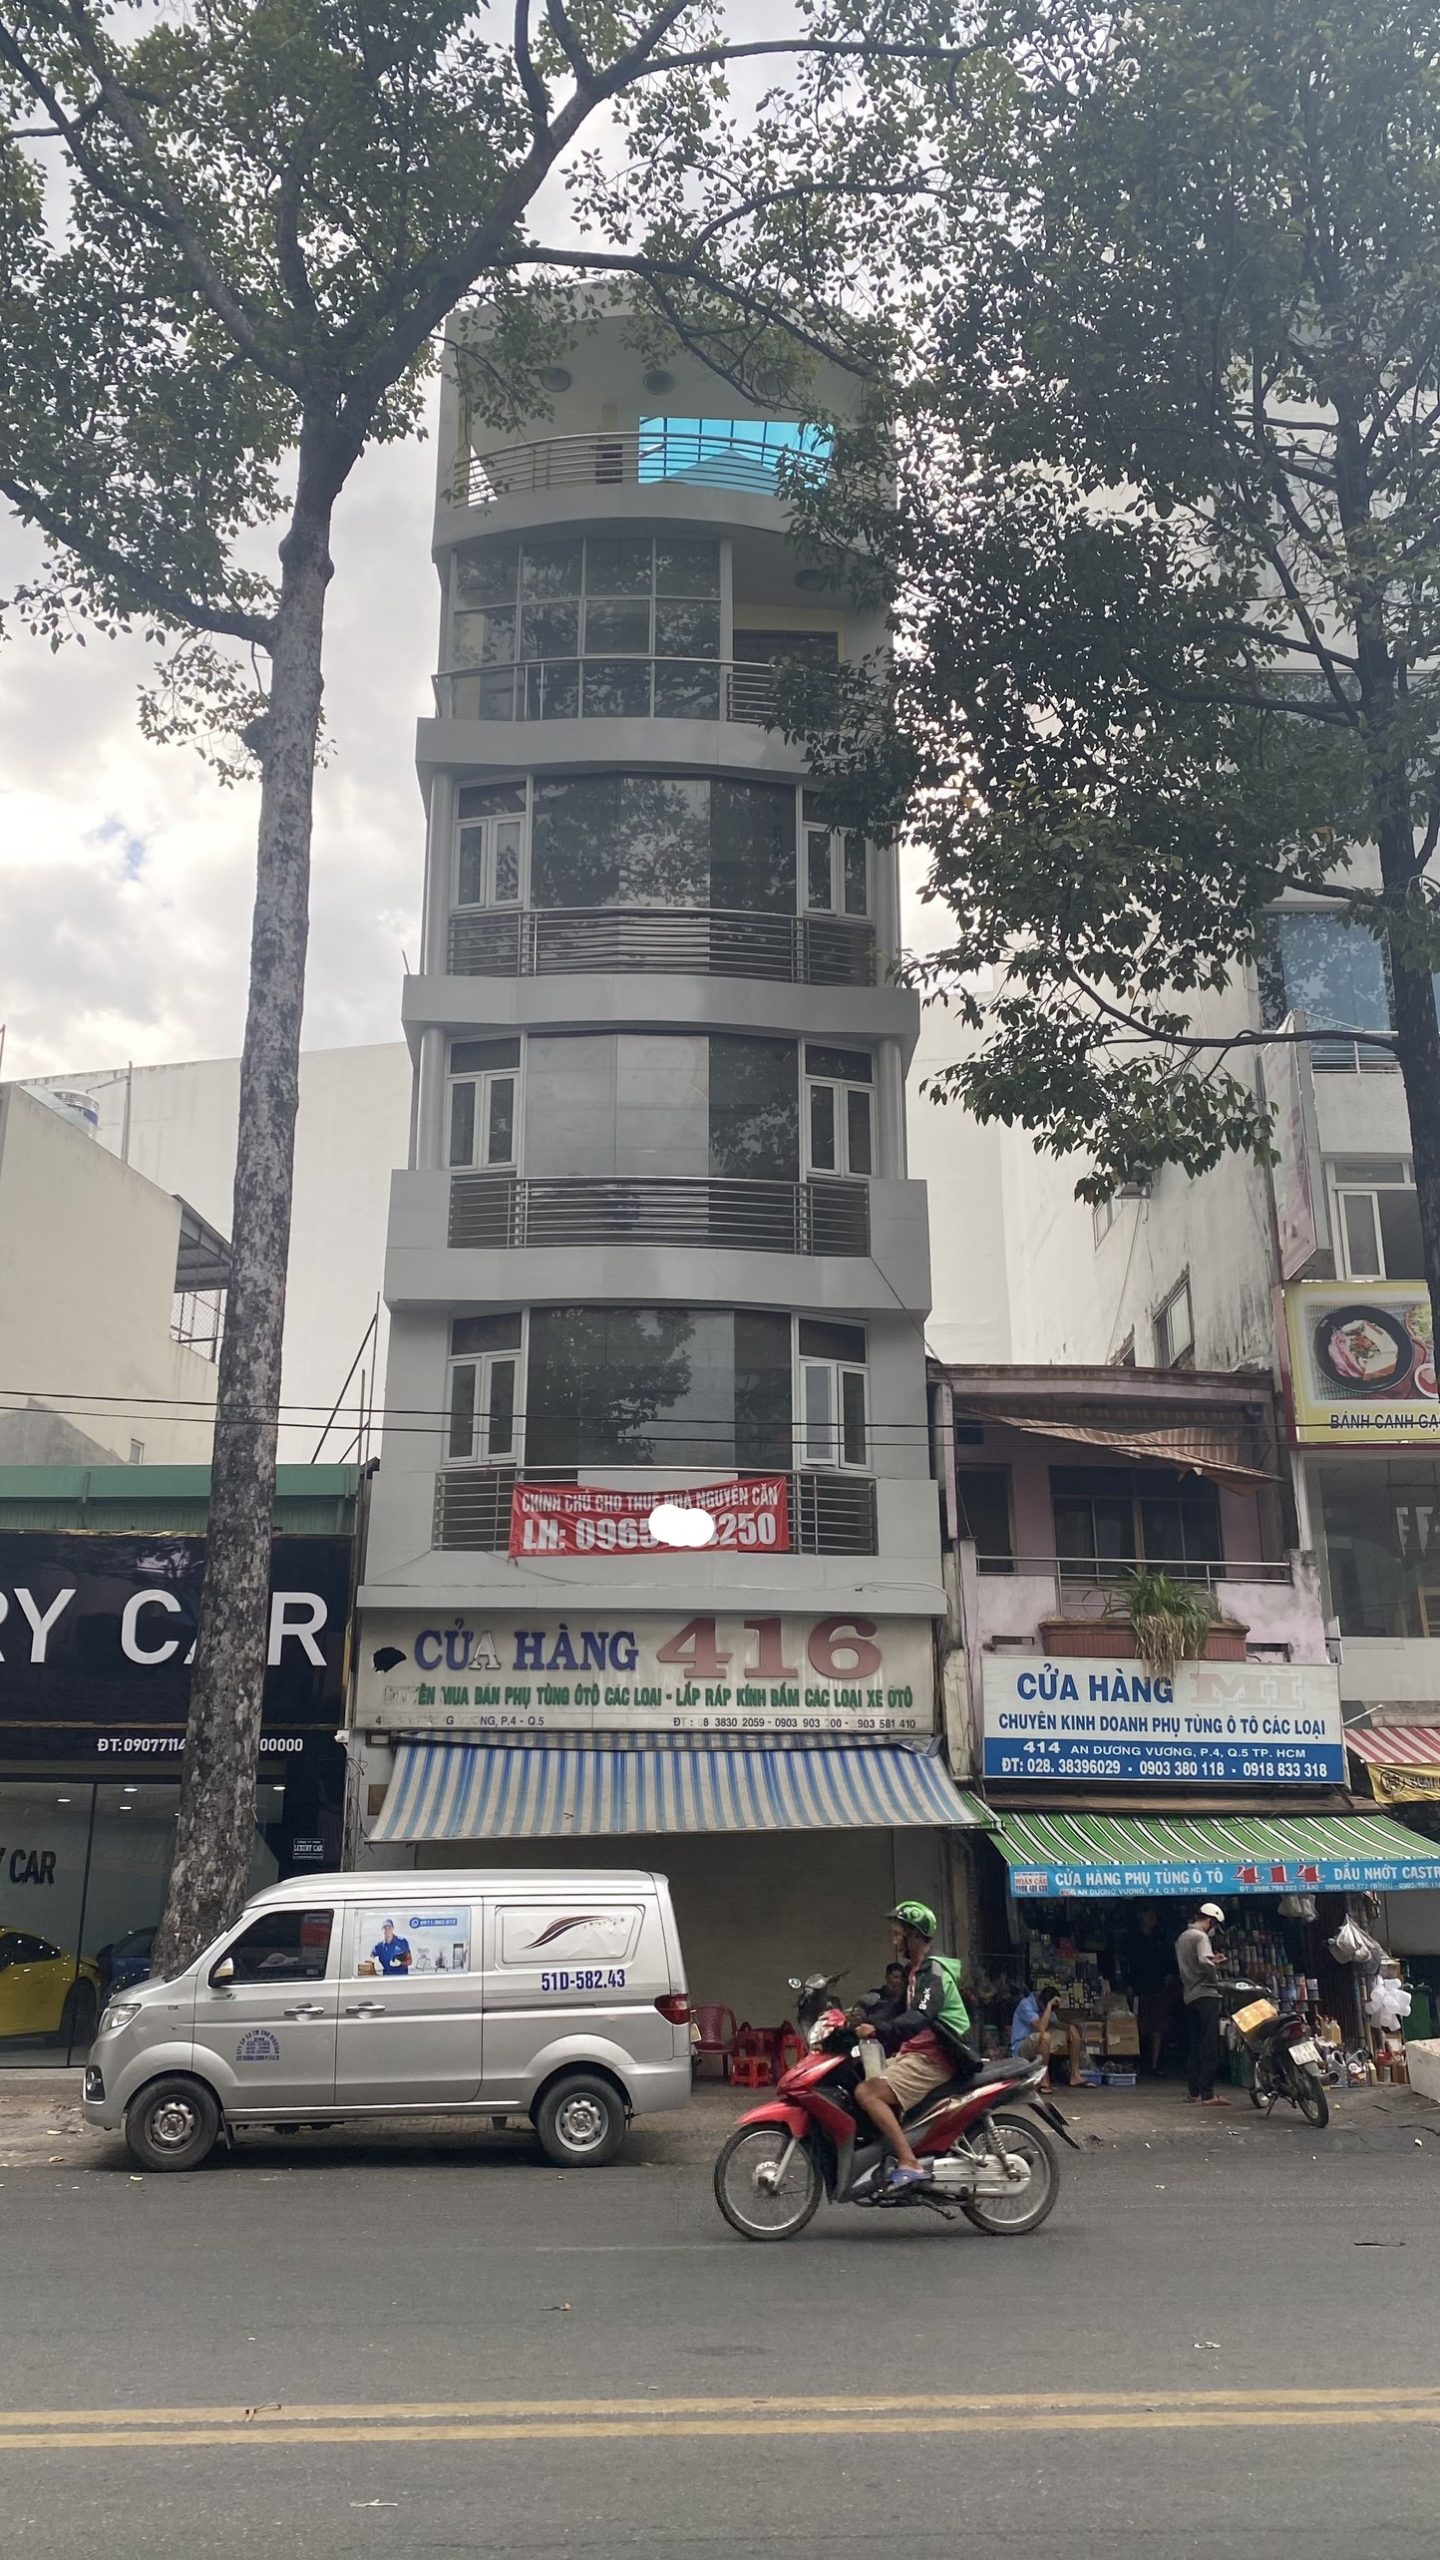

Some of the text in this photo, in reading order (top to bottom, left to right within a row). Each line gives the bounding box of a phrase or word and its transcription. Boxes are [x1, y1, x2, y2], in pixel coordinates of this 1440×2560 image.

[1330, 1410, 1440, 1432] BÁNH CANH GẠ
[522, 1488, 561, 1513] CHÍNH
[595, 1491, 622, 1513] CHO
[626, 1490, 660, 1511] THUÊ
[696, 1485, 749, 1509] NGUYÊN
[752, 1483, 778, 1506] CĂN
[523, 1519, 566, 1551] LH:
[121, 1589, 328, 1666] CR
[414, 1615, 882, 1680] CỬA HÀNG 416
[504, 1685, 532, 1709] PHỤ
[536, 1682, 570, 1706] TÙNG
[633, 1686, 662, 1710] LOẠI
[705, 1682, 731, 1708] RÁP
[736, 1682, 767, 1708] KÍNH
[834, 1688, 862, 1711] LOẠI
[866, 1688, 883, 1708] XE
[1017, 1663, 1079, 1701] CỬA
[1089, 1668, 1174, 1704] HÀNG
[501, 1716, 516, 1725] P.4
[528, 1716, 545, 1726] Q.5
[715, 1717, 738, 1728] 3830
[742, 1717, 765, 1728] 2059
[775, 1717, 798, 1728] 0903
[803, 1718, 820, 1728] 903
[879, 1718, 896, 1729] 581
[899, 1719, 917, 1729] 410
[999, 1711, 1325, 1740] CHUYÊN KINH DOANH PHỤ TÙNG Ô TÔ CÁC LOẠI
[1023, 1741, 1306, 1759] 414 AN DƯƠNG VƯƠNG, P.4, Q.5 TP. HCM
[1001, 1757, 1024, 1773] ĐT:
[1027, 1758, 1055, 1774] 028.
[1058, 1758, 1121, 1775] 38396029
[1139, 1760, 1171, 1776] 0903
[1174, 1761, 1198, 1776] 380
[1201, 1761, 1225, 1776] 118
[1243, 1762, 1274, 1777] 0918
[1277, 1763, 1301, 1777] 833
[1304, 1763, 1328, 1777] 318
[10, 1849, 57, 1884] CAR
[1055, 1868, 1081, 1886] CỬA
[1085, 1868, 1121, 1886] HÀNG
[1125, 1871, 1151, 1889] PHỤ
[1154, 1868, 1190, 1885] TÙNG
[1193, 1867, 1202, 1884] Ô
[1206, 1867, 1224, 1884] TÔ
[1231, 1864, 1325, 1885] 414
[1334, 1863, 1360, 1882] DẦU
[1364, 1863, 1397, 1880] NHỚT
[541, 1969, 626, 1991] 51D-582.43
